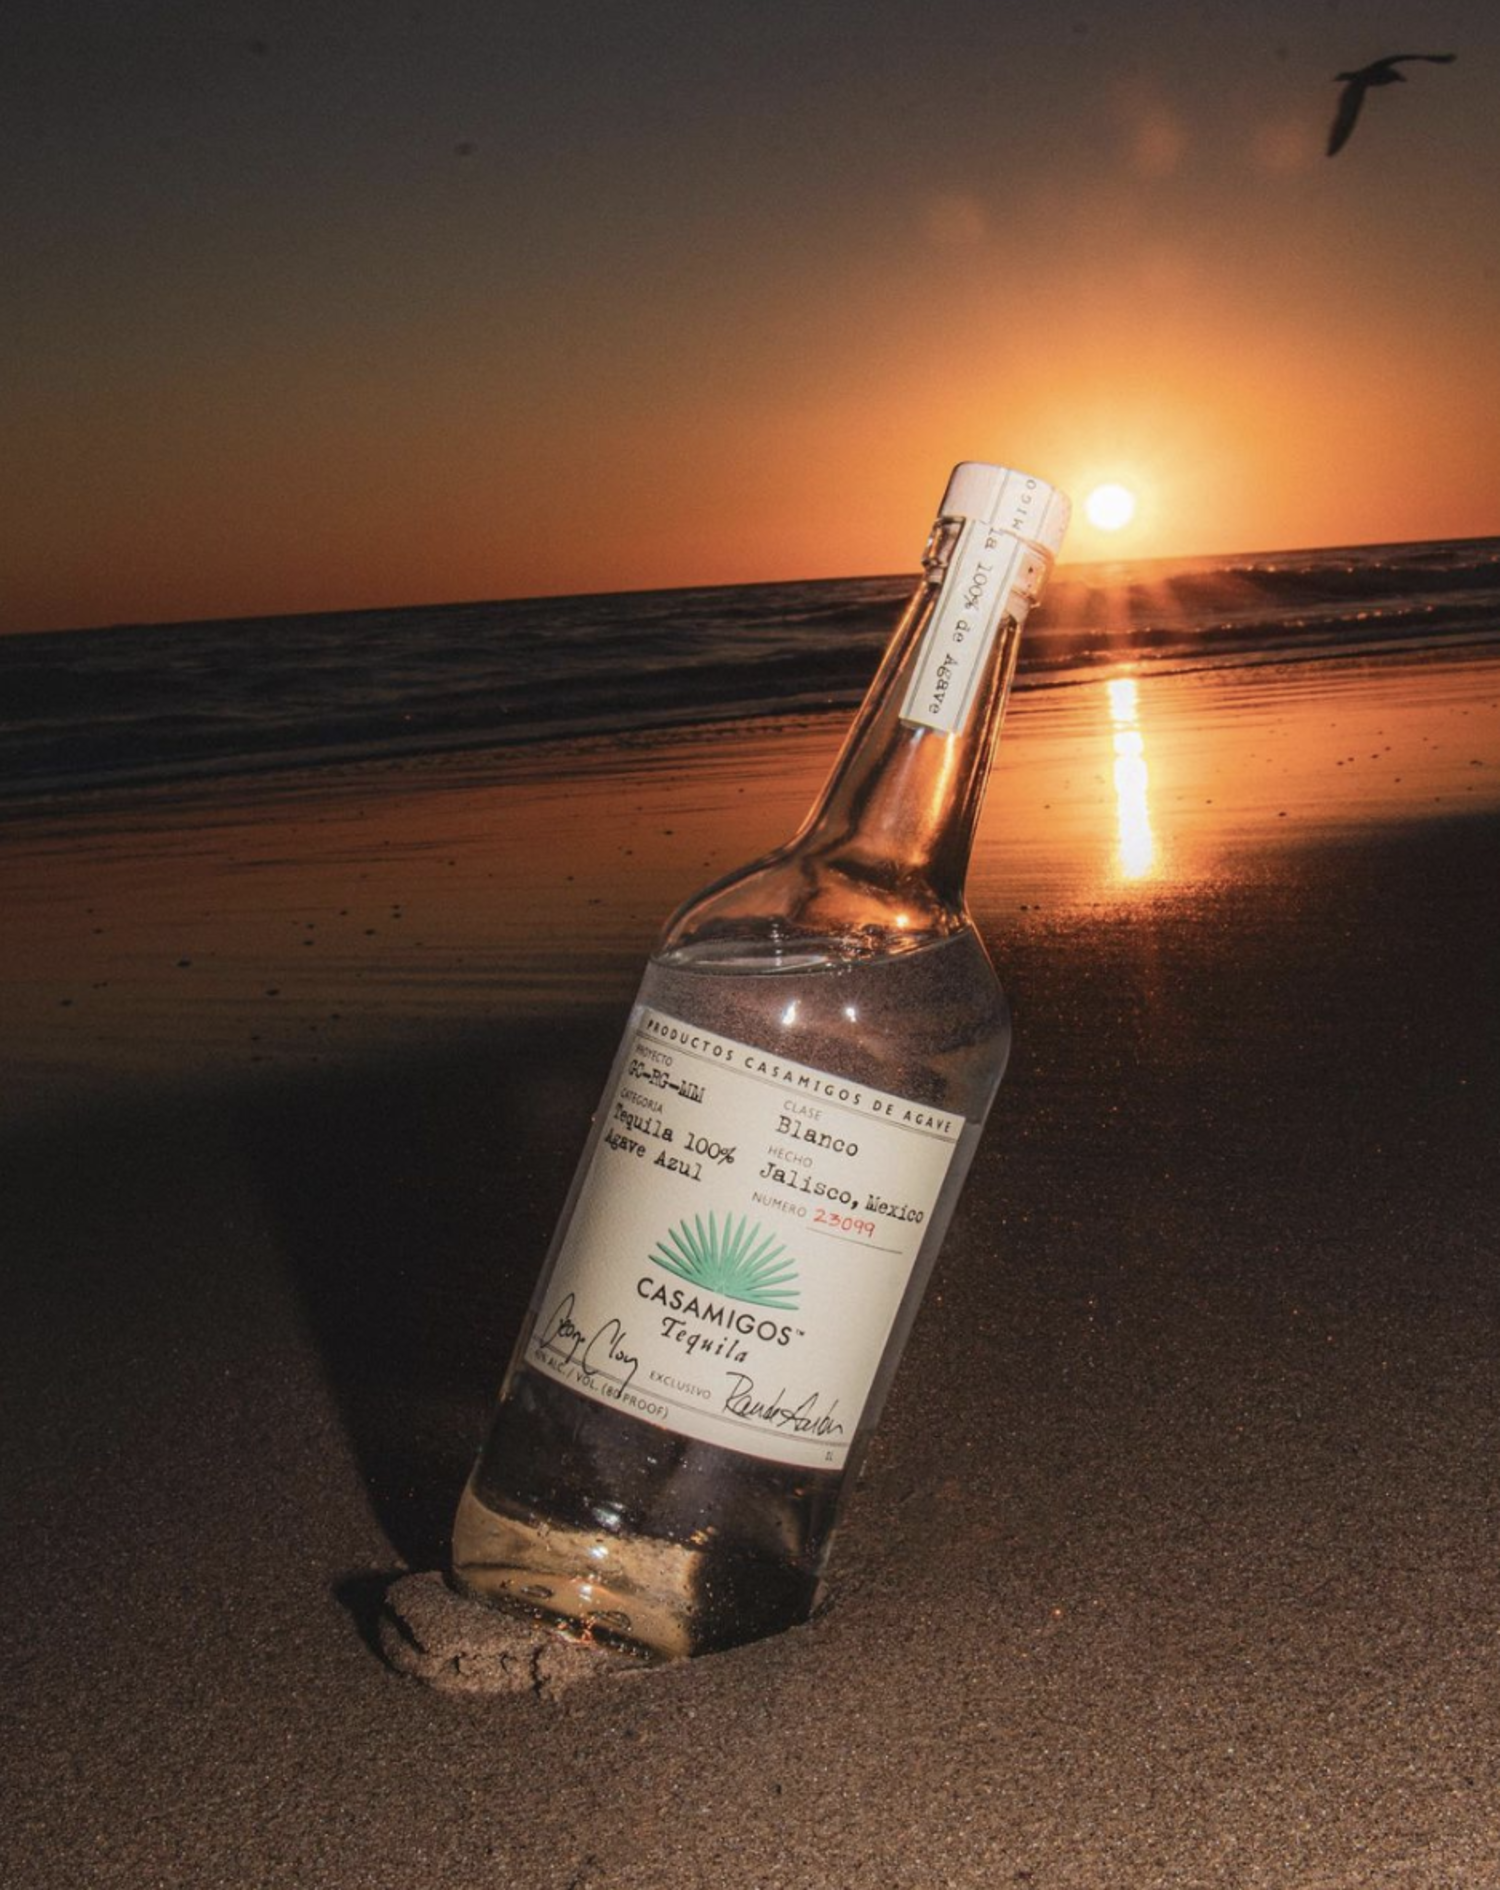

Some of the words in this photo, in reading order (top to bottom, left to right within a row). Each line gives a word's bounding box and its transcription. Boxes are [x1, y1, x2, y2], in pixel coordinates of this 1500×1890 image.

[963, 561, 993, 611] 100%
[952, 619, 971, 643] de
[928, 652, 958, 714] Agave
[635, 1043, 674, 1068] PROYECTO
[646, 1018, 735, 1061] PRODUCTOS
[744, 1056, 863, 1105] CASAMIGOS
[872, 1100, 894, 1116] DE
[903, 1110, 952, 1134] AGAVE
[619, 1086, 664, 1115] CATEGORIA
[783, 1099, 824, 1122] CLASE
[604, 1127, 646, 1158] Agave
[653, 1149, 702, 1182] Azul
[613, 1102, 673, 1142] Tequila
[684, 1132, 737, 1165] 100%
[767, 1145, 814, 1169] HECHO
[775, 1114, 860, 1157] Blanco
[752, 1191, 808, 1218] NUMERO
[812, 1208, 876, 1239] 23099
[759, 1162, 860, 1211] Jalisco,
[865, 1194, 925, 1225] Mexico
[637, 1277, 793, 1346] CASAMIGOS
[660, 1316, 749, 1363] Tequila
[622, 1392, 669, 1420] PROOF)
[649, 1369, 712, 1400] EXCLUSIVO
